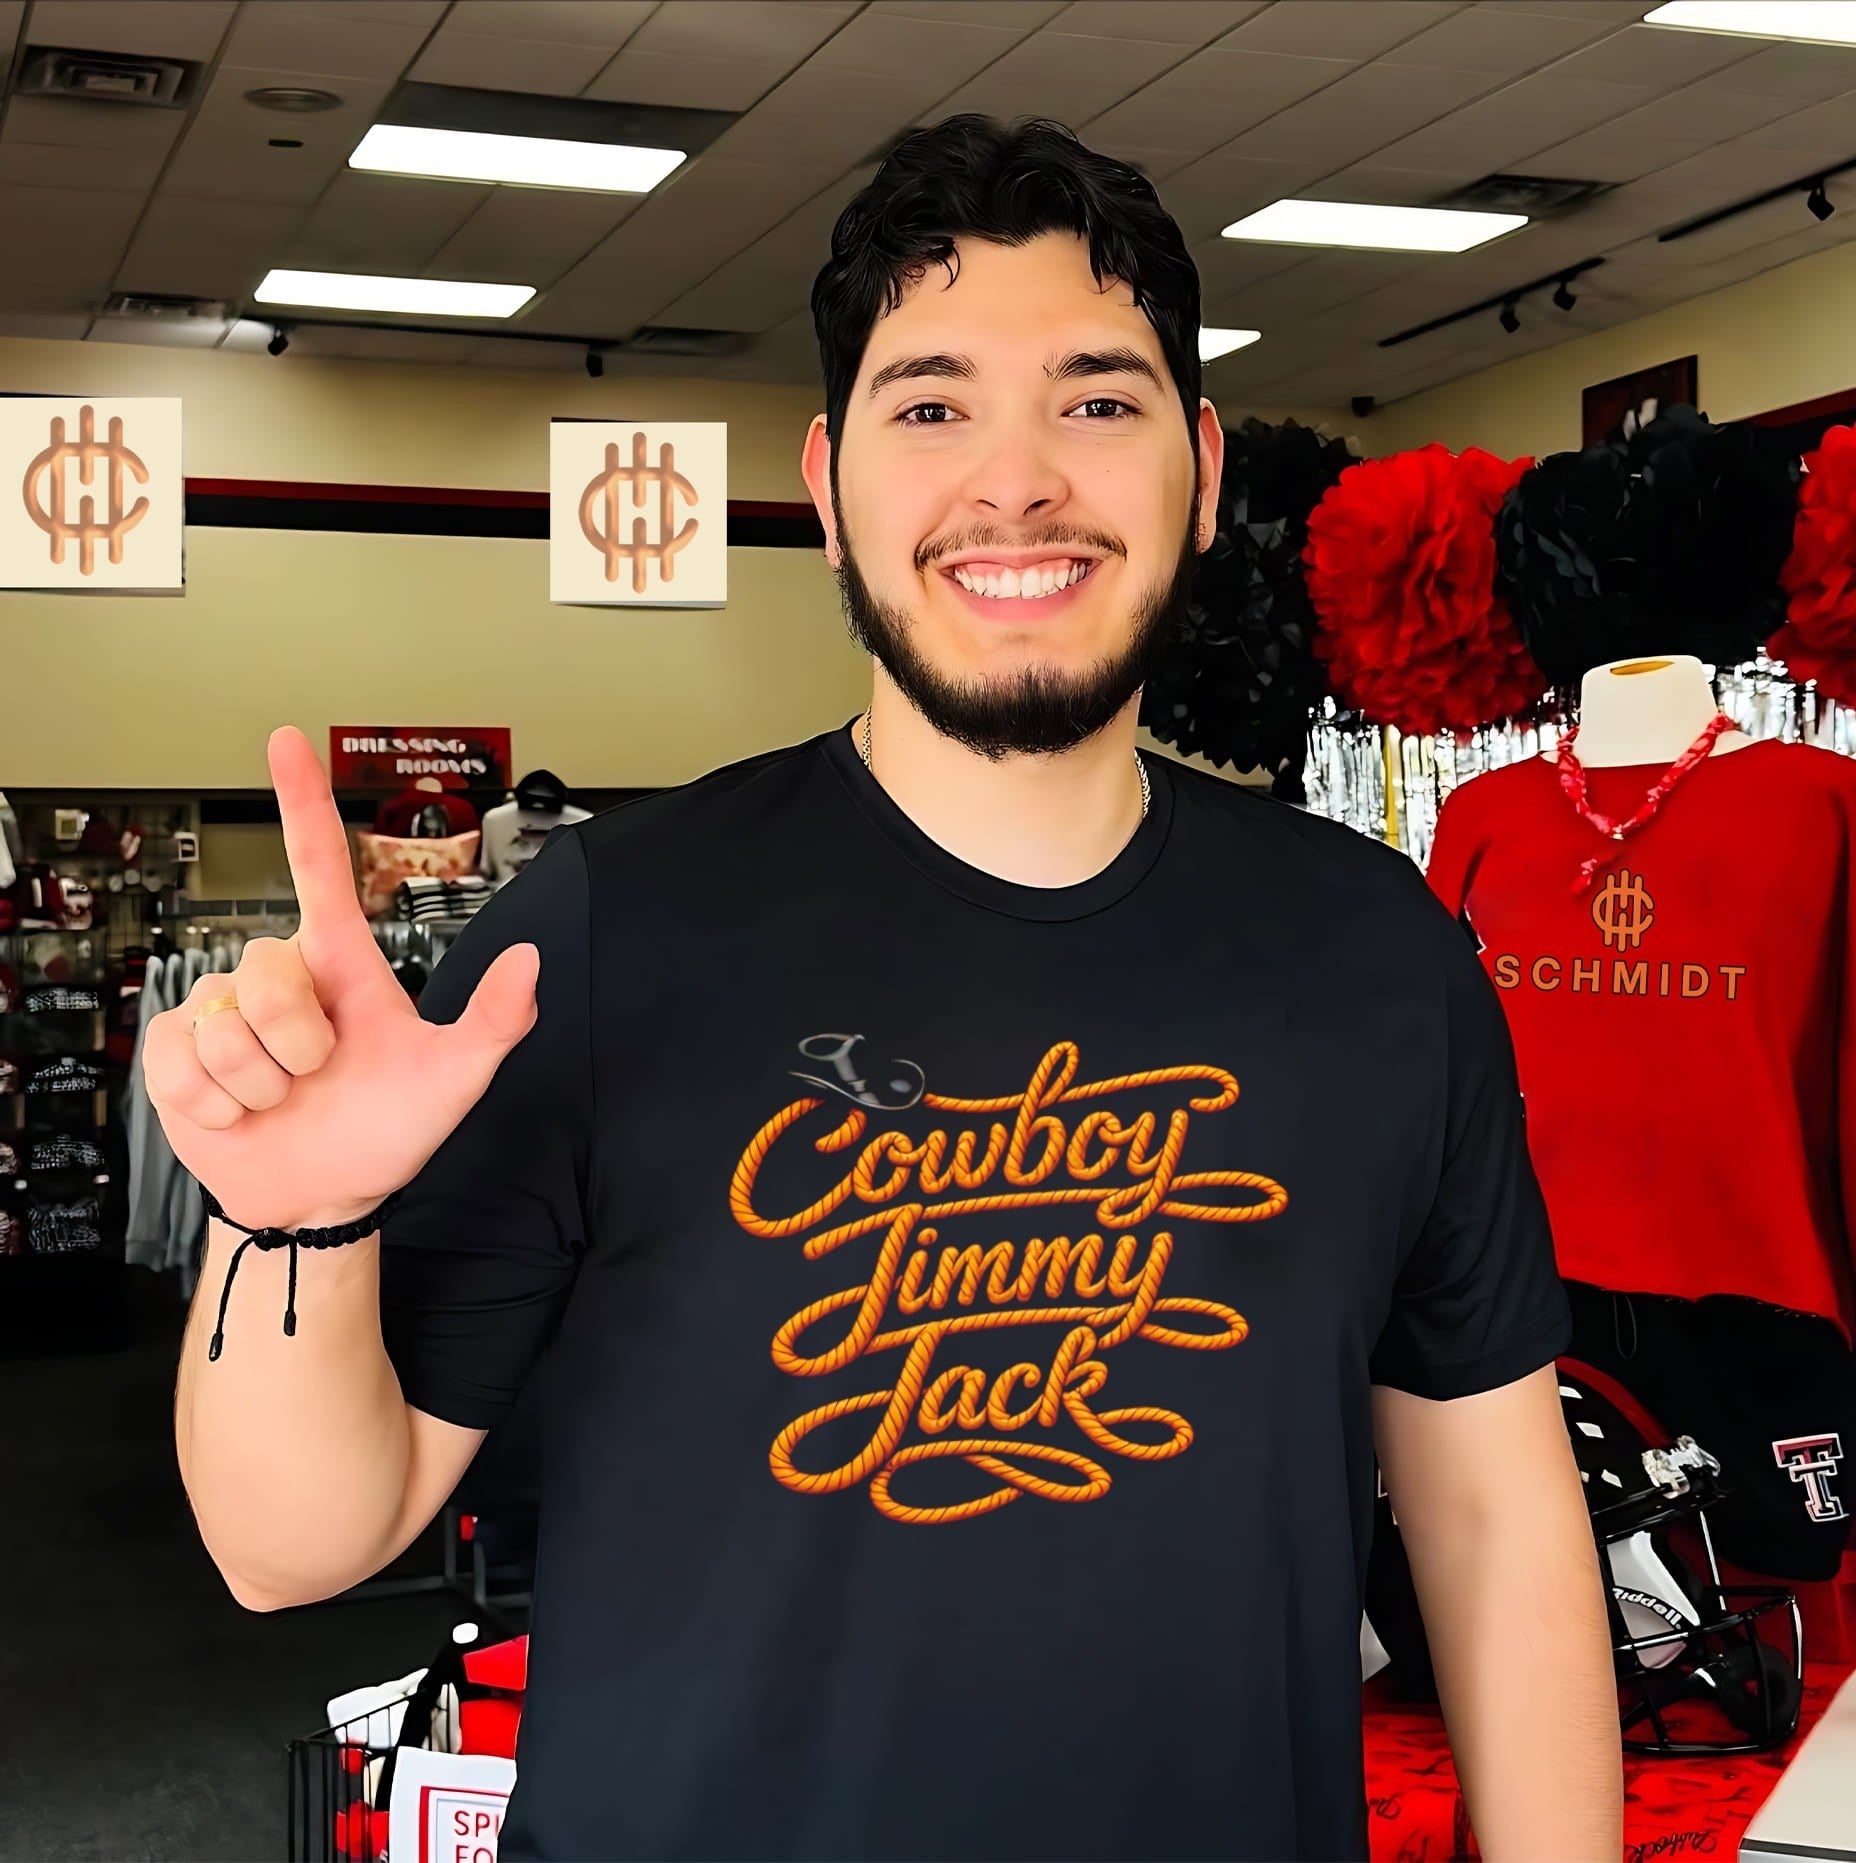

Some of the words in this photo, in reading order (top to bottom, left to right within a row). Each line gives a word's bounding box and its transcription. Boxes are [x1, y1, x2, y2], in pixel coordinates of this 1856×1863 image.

[342, 737, 467, 753] DRESSING
[396, 758, 487, 774] ROOMS
[1494, 954, 1746, 1000] SCHMIDT
[730, 1041, 1288, 1238] Cowboy
[771, 1202, 1249, 1377] Jimmy
[769, 1322, 1194, 1523] Jack
